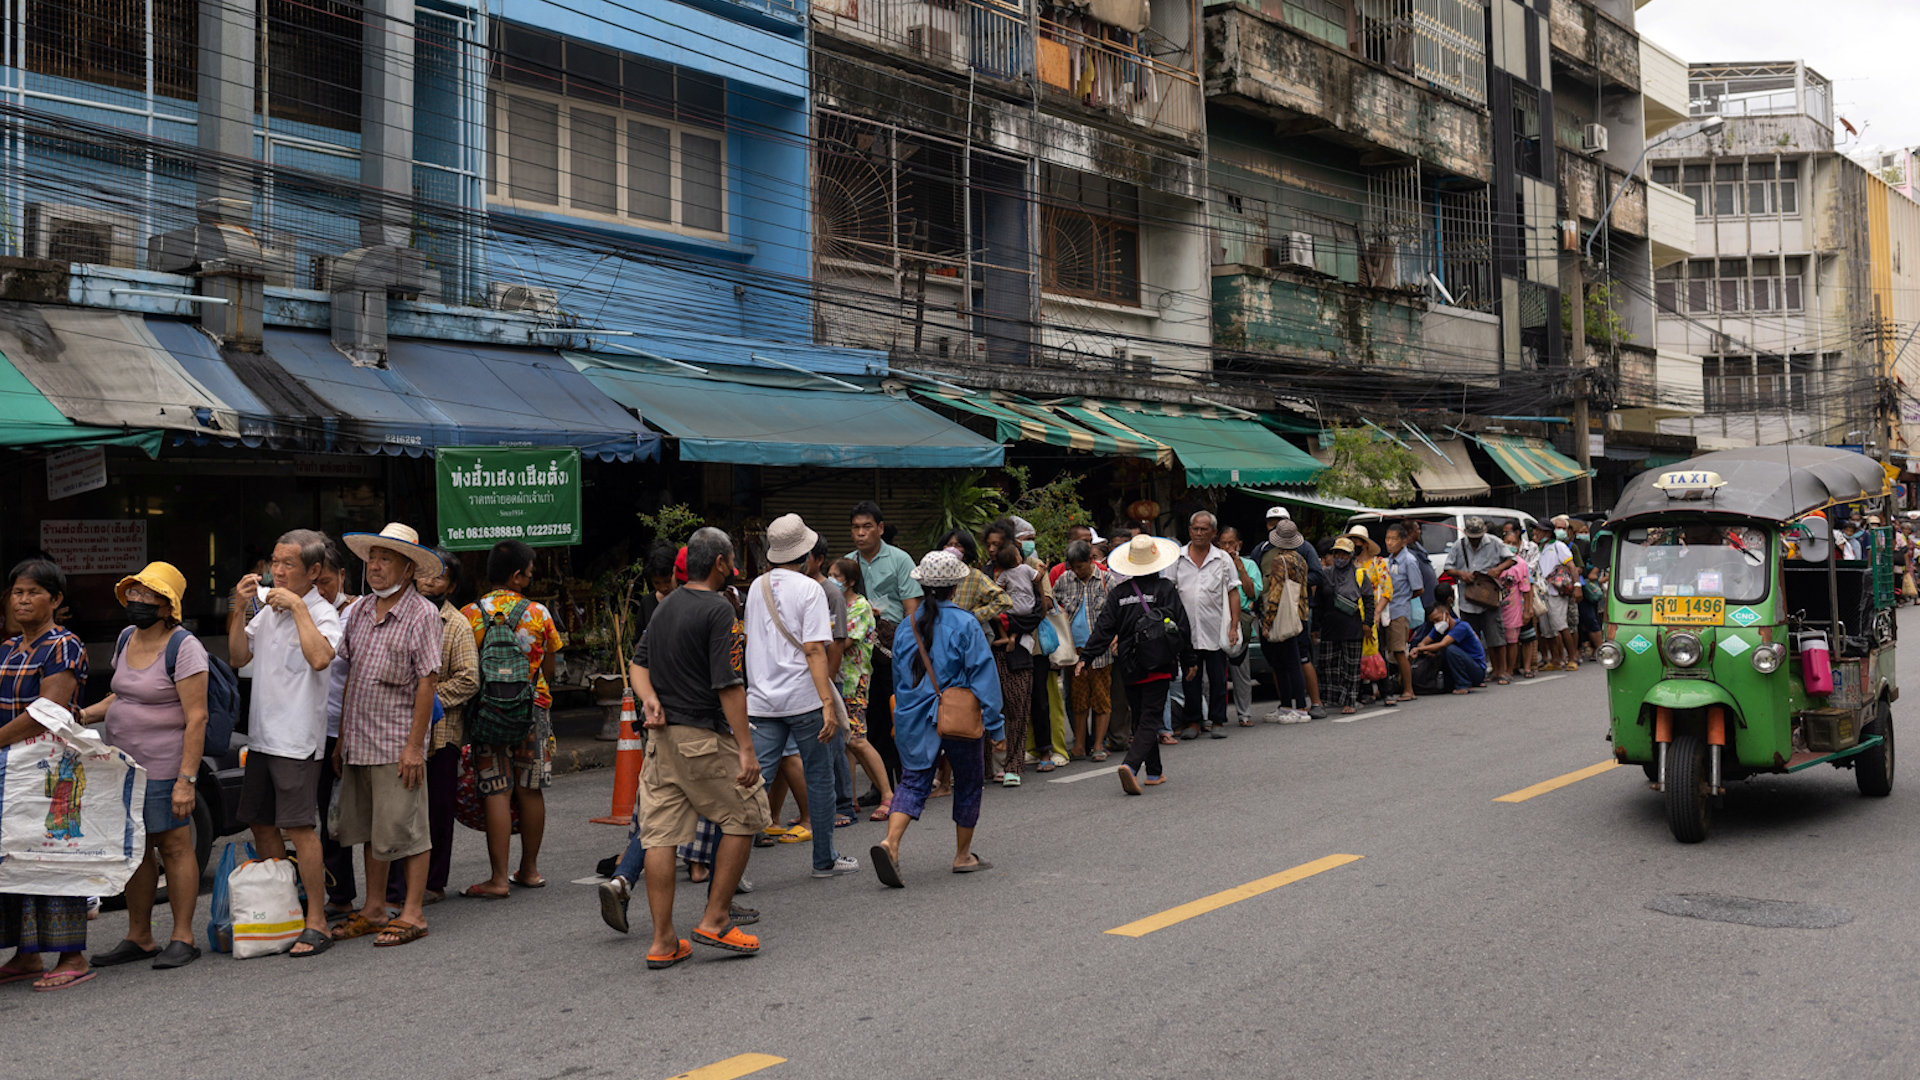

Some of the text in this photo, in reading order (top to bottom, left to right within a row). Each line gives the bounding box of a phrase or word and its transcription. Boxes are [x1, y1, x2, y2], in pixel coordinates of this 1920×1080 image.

[1669, 474, 1708, 484] TAXI
[448, 529, 464, 540] Tel:
[466, 525, 525, 540] 0816388819,
[1685, 599, 1722, 613] 1496
[1735, 612, 1756, 621] CNG
[1631, 640, 1648, 648] CNG
